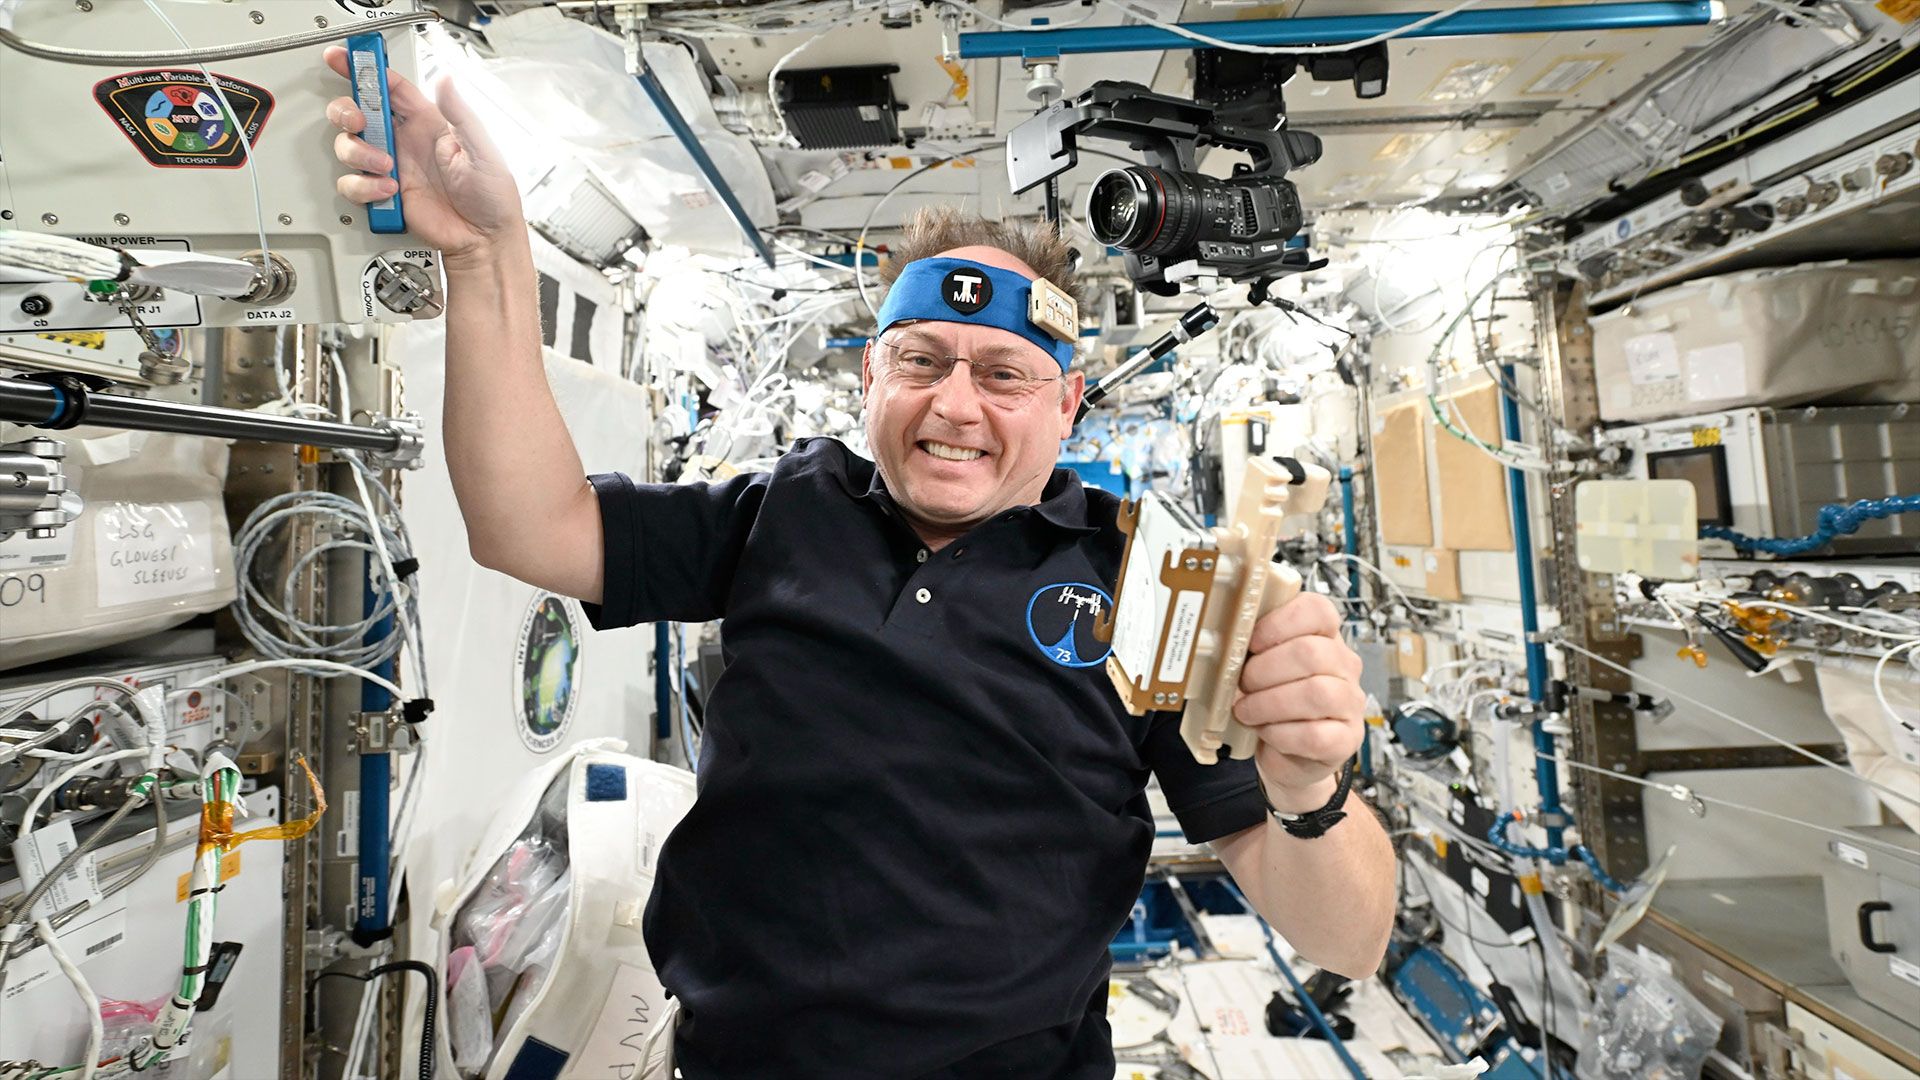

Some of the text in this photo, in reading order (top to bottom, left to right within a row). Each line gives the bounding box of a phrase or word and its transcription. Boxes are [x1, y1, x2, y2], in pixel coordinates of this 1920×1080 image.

[117, 73, 161, 89] Multi-use
[171, 114, 200, 124] MVP
[119, 117, 138, 137] NASA
[175, 156, 218, 165] TECHSHOT
[111, 236, 156, 246] POWER
[404, 250, 432, 259] OPEN
[363, 280, 374, 317] CLOSE
[149, 305, 161, 314] J1
[247, 310, 292, 320] DATA J2
[33, 318, 49, 327] cb
[133, 567, 190, 585] SLEEVES
[1055, 647, 1072, 662] 73
